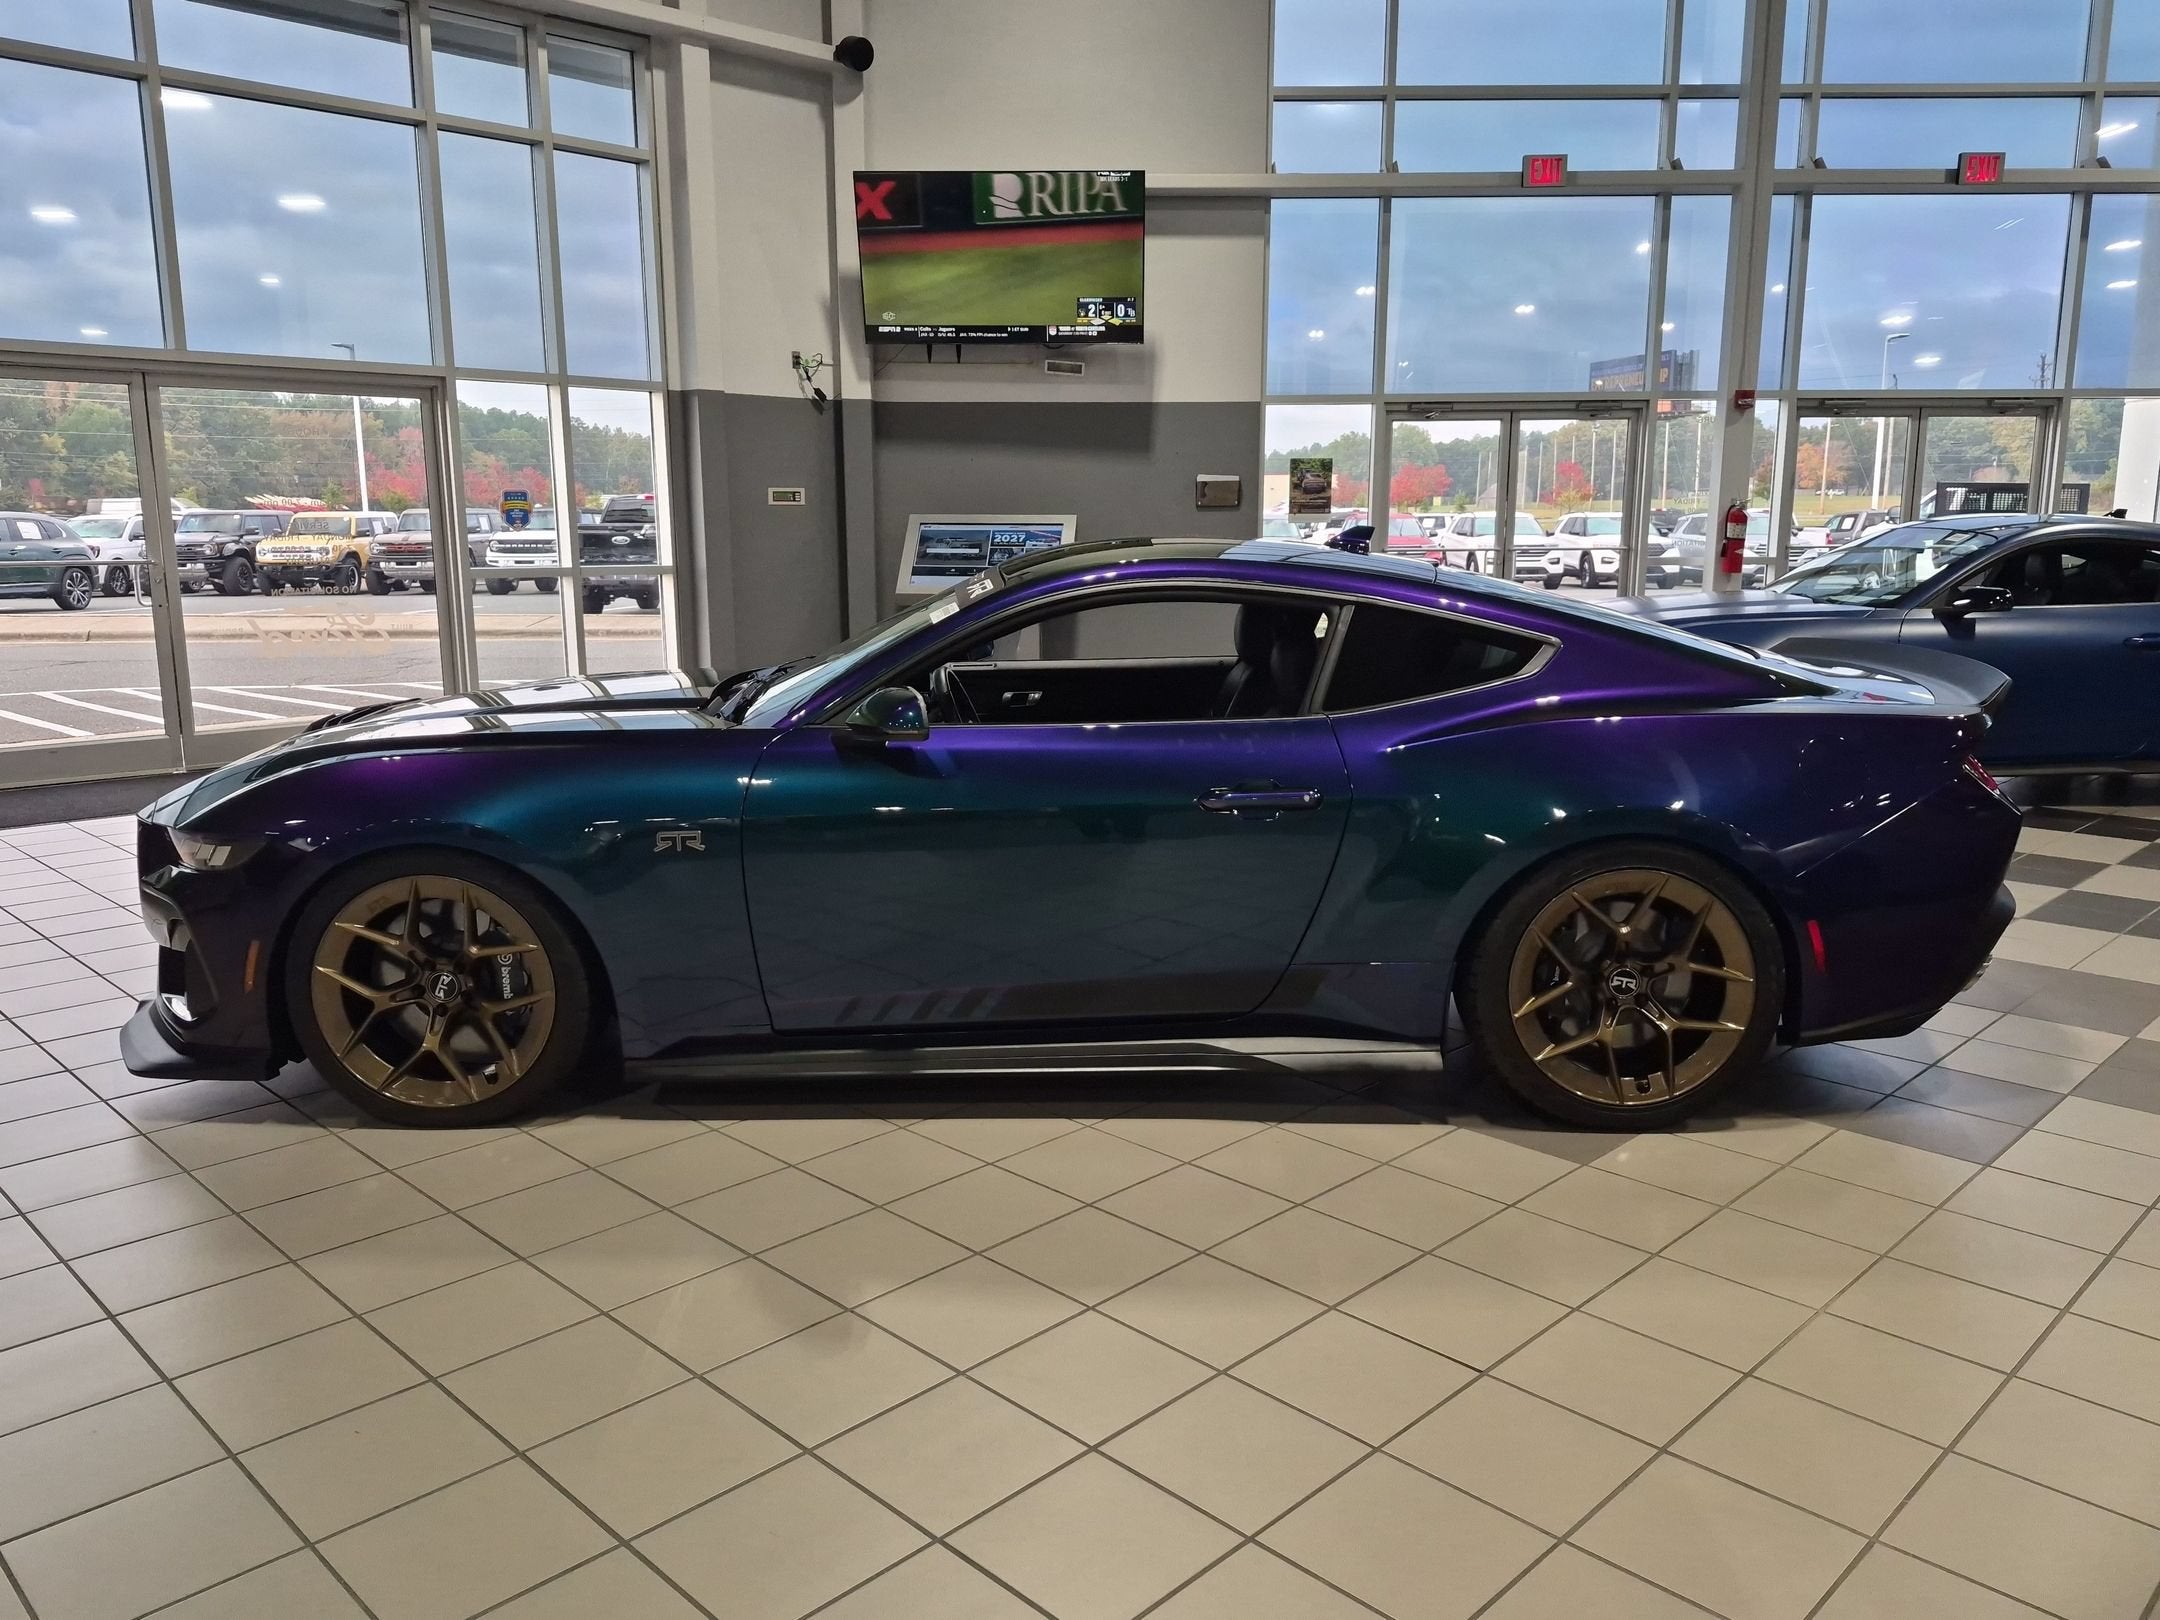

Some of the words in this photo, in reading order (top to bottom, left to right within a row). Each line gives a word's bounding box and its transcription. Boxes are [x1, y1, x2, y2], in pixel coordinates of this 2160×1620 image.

[1530, 158, 1563, 184] EXIT
[1967, 155, 2001, 182] EXIT
[1028, 172, 1129, 217] RIPA
[1087, 303, 1096, 318] 2
[1117, 303, 1126, 317] 0
[994, 534, 1026, 542] 2027
[653, 831, 706, 852] RTR
[500, 966, 514, 999] bremb
